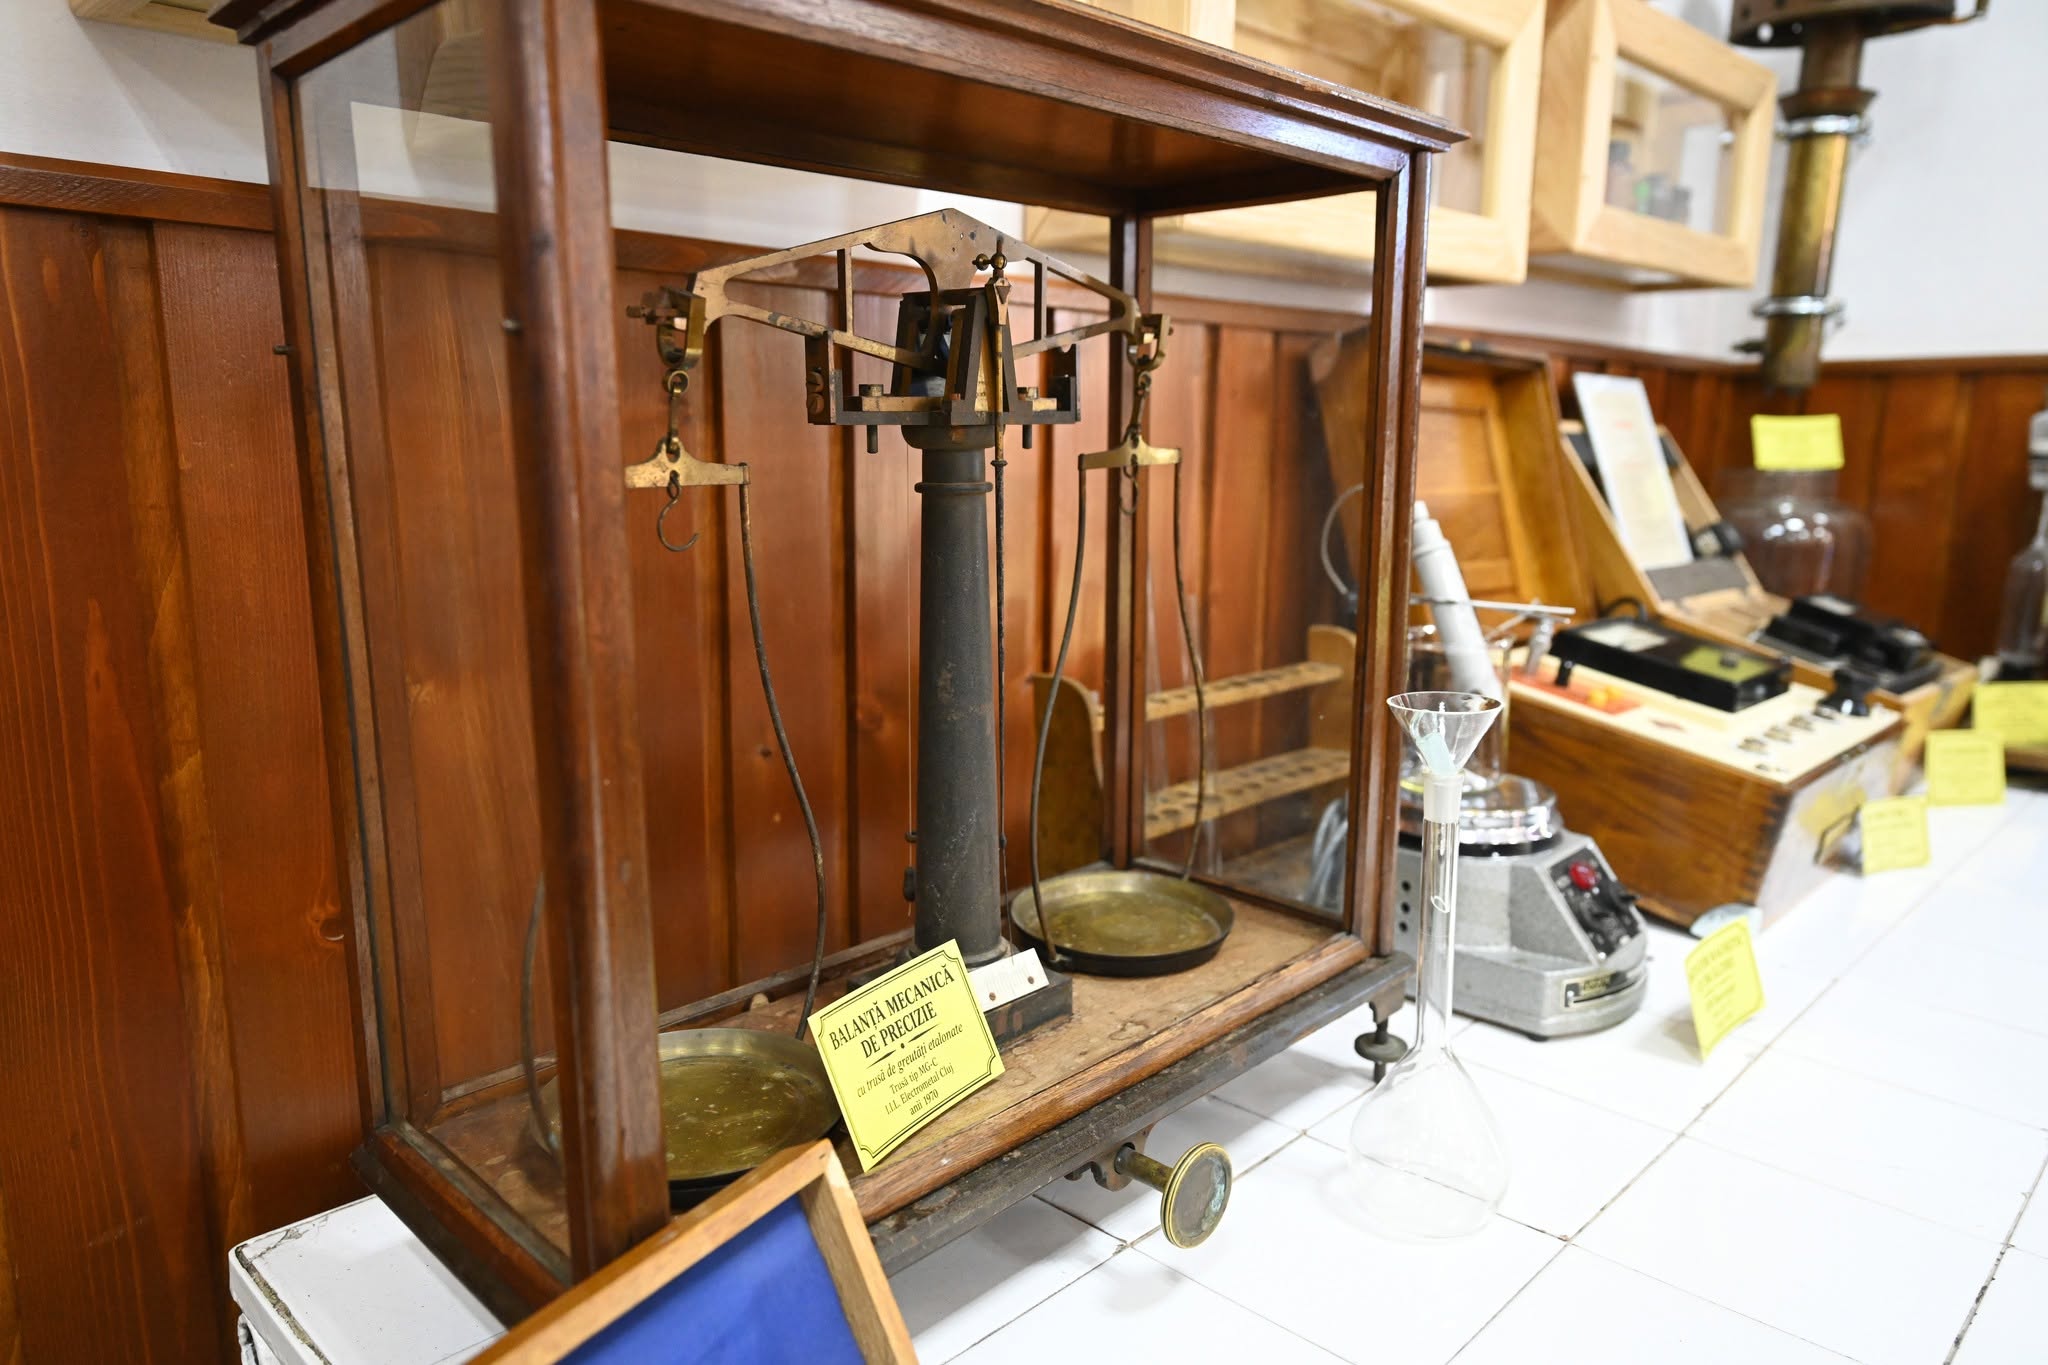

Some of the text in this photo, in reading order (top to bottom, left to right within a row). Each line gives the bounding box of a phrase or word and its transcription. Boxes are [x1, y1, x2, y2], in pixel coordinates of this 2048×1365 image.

[829, 964, 954, 1050] BALANȚĂ MECANICĂ
[861, 1002, 937, 1058] DE PRECIZIE
[857, 1024, 963, 1097] cu trusă de greutăți etalonate
[889, 1077, 909, 1095] Trusă
[909, 1071, 919, 1082] tip
[900, 1071, 940, 1104] Electrometal
[939, 1063, 955, 1078] Cluj
[909, 1088, 939, 1115] anii 1970
